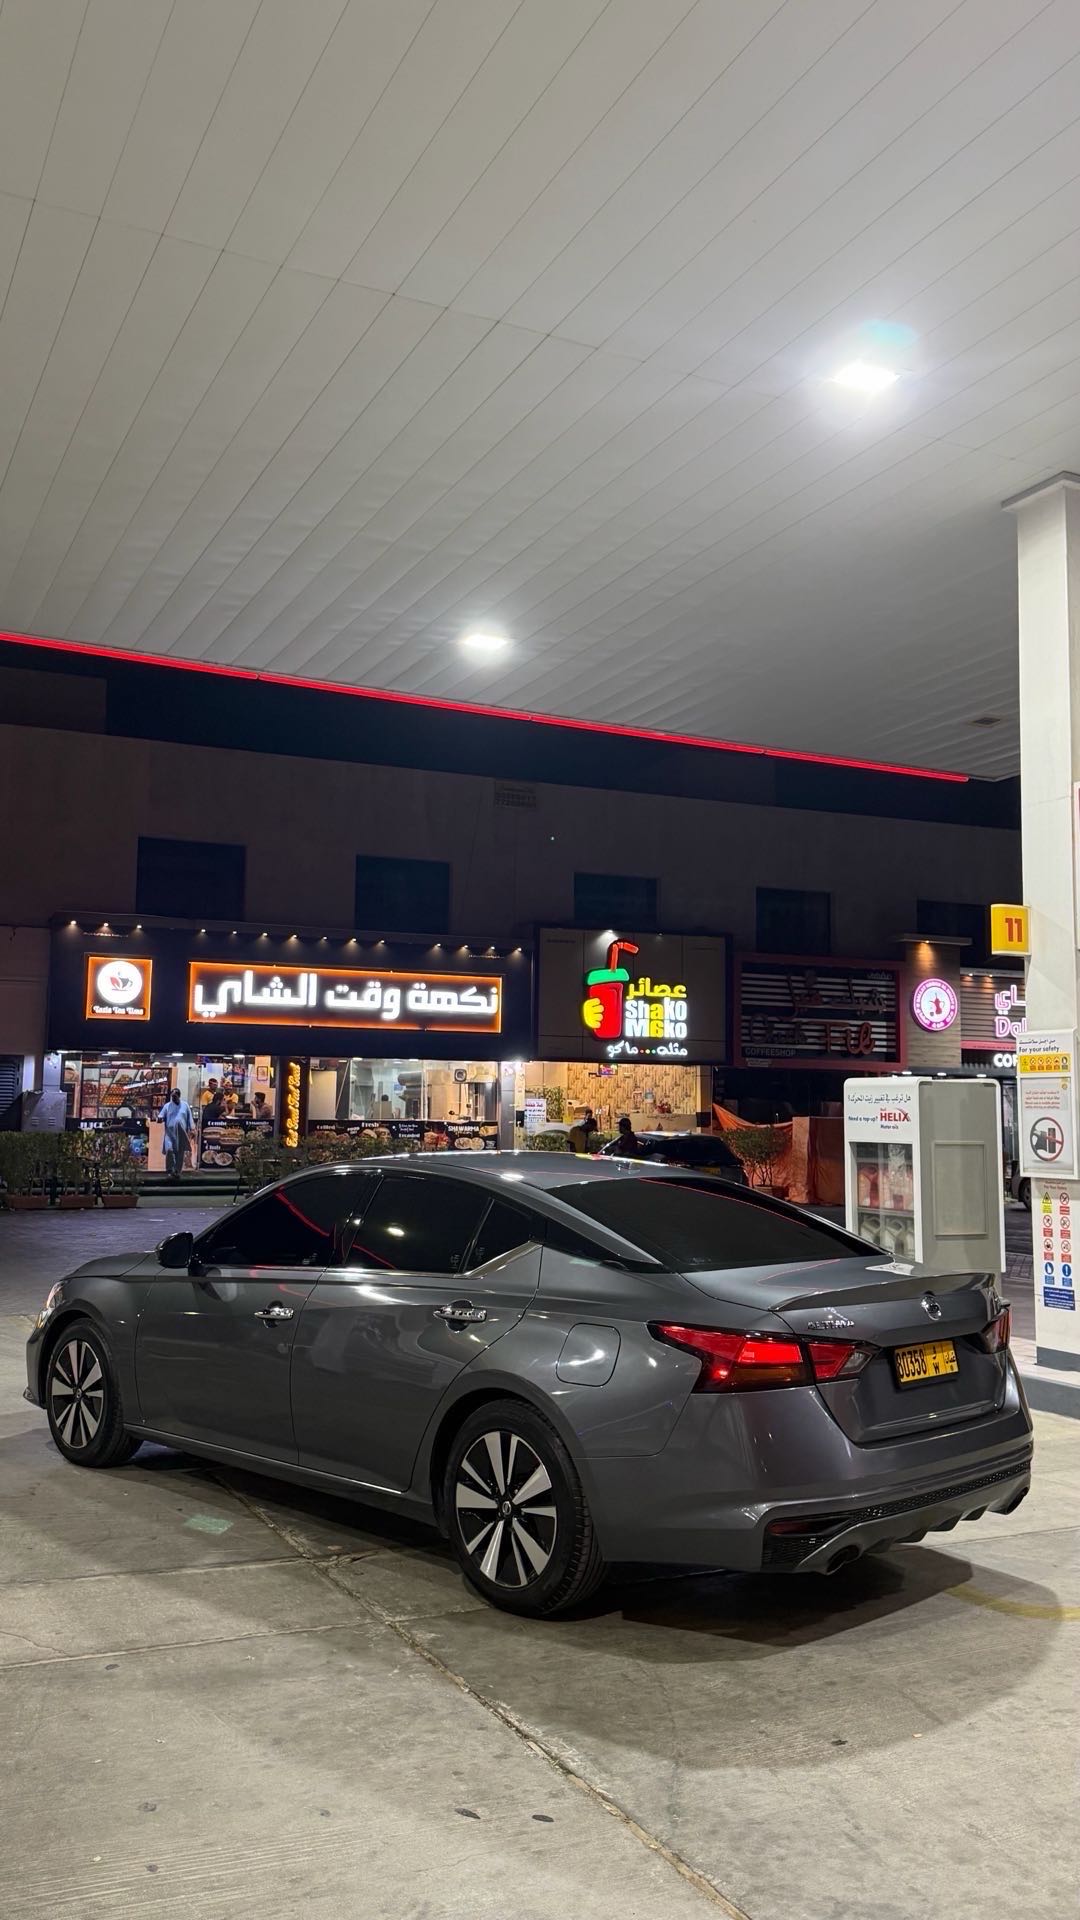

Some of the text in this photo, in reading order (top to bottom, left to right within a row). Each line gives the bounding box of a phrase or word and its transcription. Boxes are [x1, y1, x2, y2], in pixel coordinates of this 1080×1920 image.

[1003, 917, 1024, 943] 11
[193, 970, 499, 1021] نكهة وقت الشاي
[626, 977, 687, 1000] عصائر
[994, 1016, 1028, 1038] Dal
[1029, 1046, 1042, 1054] your
[1042, 1045, 1060, 1053] safety
[880, 1112, 910, 1122] HELIX
[895, 1349, 928, 1379] 80358
[932, 1361, 940, 1374] W
